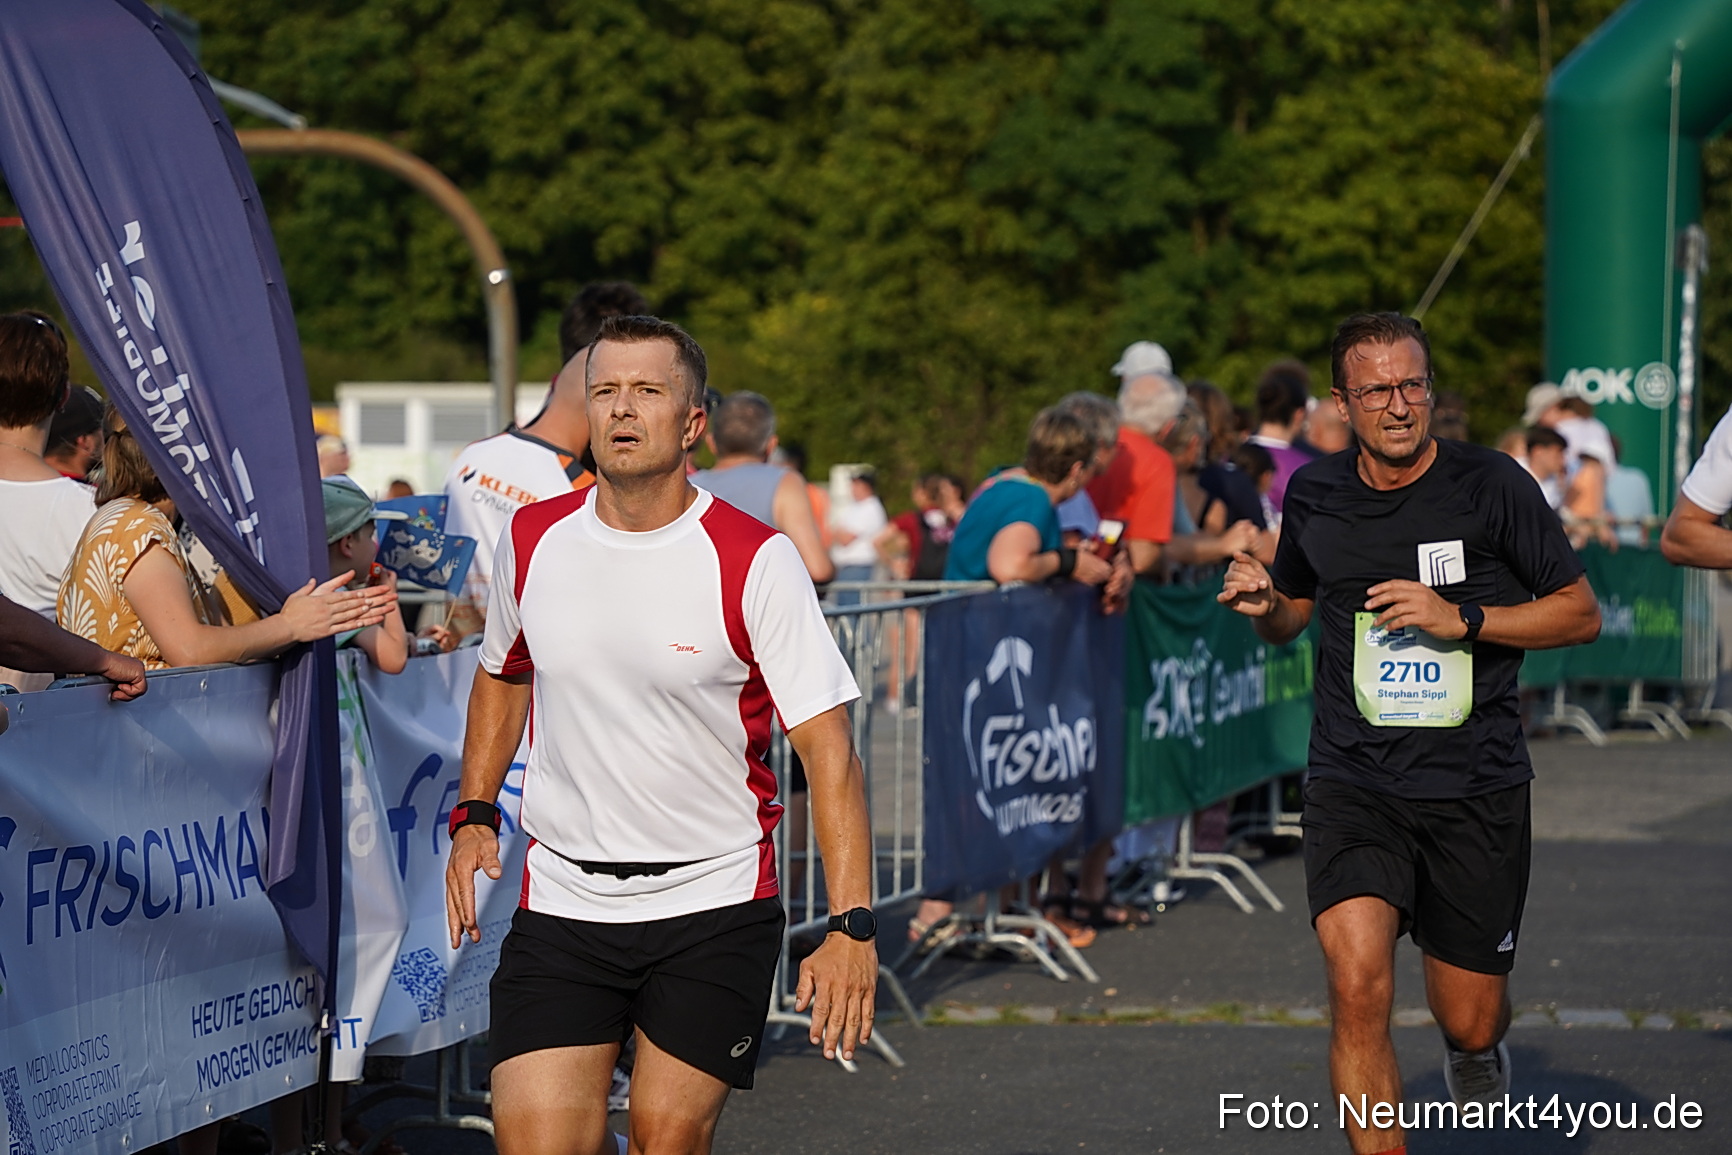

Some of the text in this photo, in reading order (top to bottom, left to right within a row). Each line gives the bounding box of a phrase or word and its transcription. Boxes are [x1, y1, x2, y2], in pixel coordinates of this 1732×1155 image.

[480, 475, 538, 504] KLEB
[1377, 689, 1447, 700] Stephan Sippl
[1379, 661, 1441, 683] 2710
[26, 806, 271, 945] FRISCHMA
[192, 973, 316, 1038] HEUTE GEDACH
[32, 1063, 121, 1120] CORPORATE PRINT
[197, 1041, 261, 1092] MORGEN
[40, 1091, 142, 1154] CORPORATE SIGNAGE
